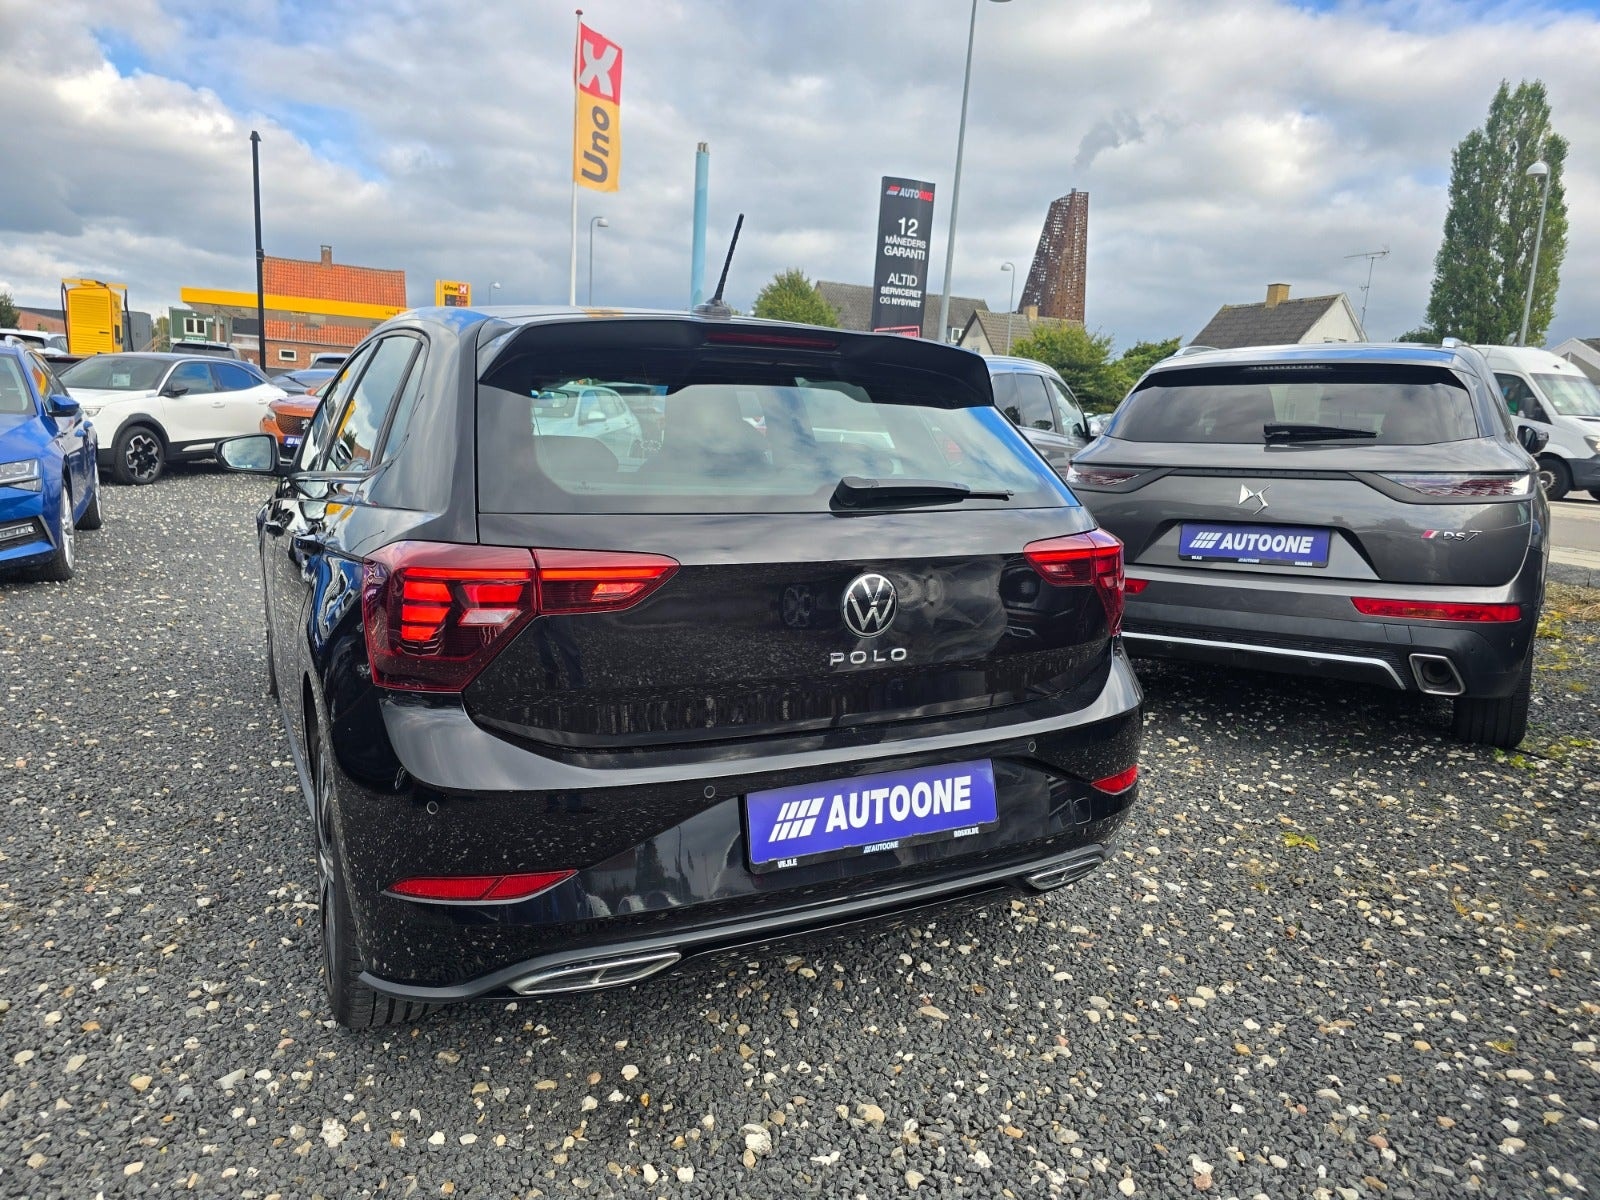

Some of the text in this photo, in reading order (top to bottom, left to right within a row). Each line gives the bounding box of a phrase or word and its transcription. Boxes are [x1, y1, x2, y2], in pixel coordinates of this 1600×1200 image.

[581, 105, 610, 184] Uno
[898, 217, 919, 237] 12
[885, 234, 926, 249] MÅNEDERS
[884, 245, 926, 260] GARANTI
[887, 272, 918, 287] ALTID
[880, 286, 922, 298] SERVICERET
[879, 296, 922, 308] OG NYSYNET
[1219, 533, 1315, 554] AUTOONE
[829, 647, 907, 667] POLO
[825, 775, 972, 833] AUTOONE
[871, 841, 899, 853] AUTOONE
[777, 857, 798, 869] VEJLE
